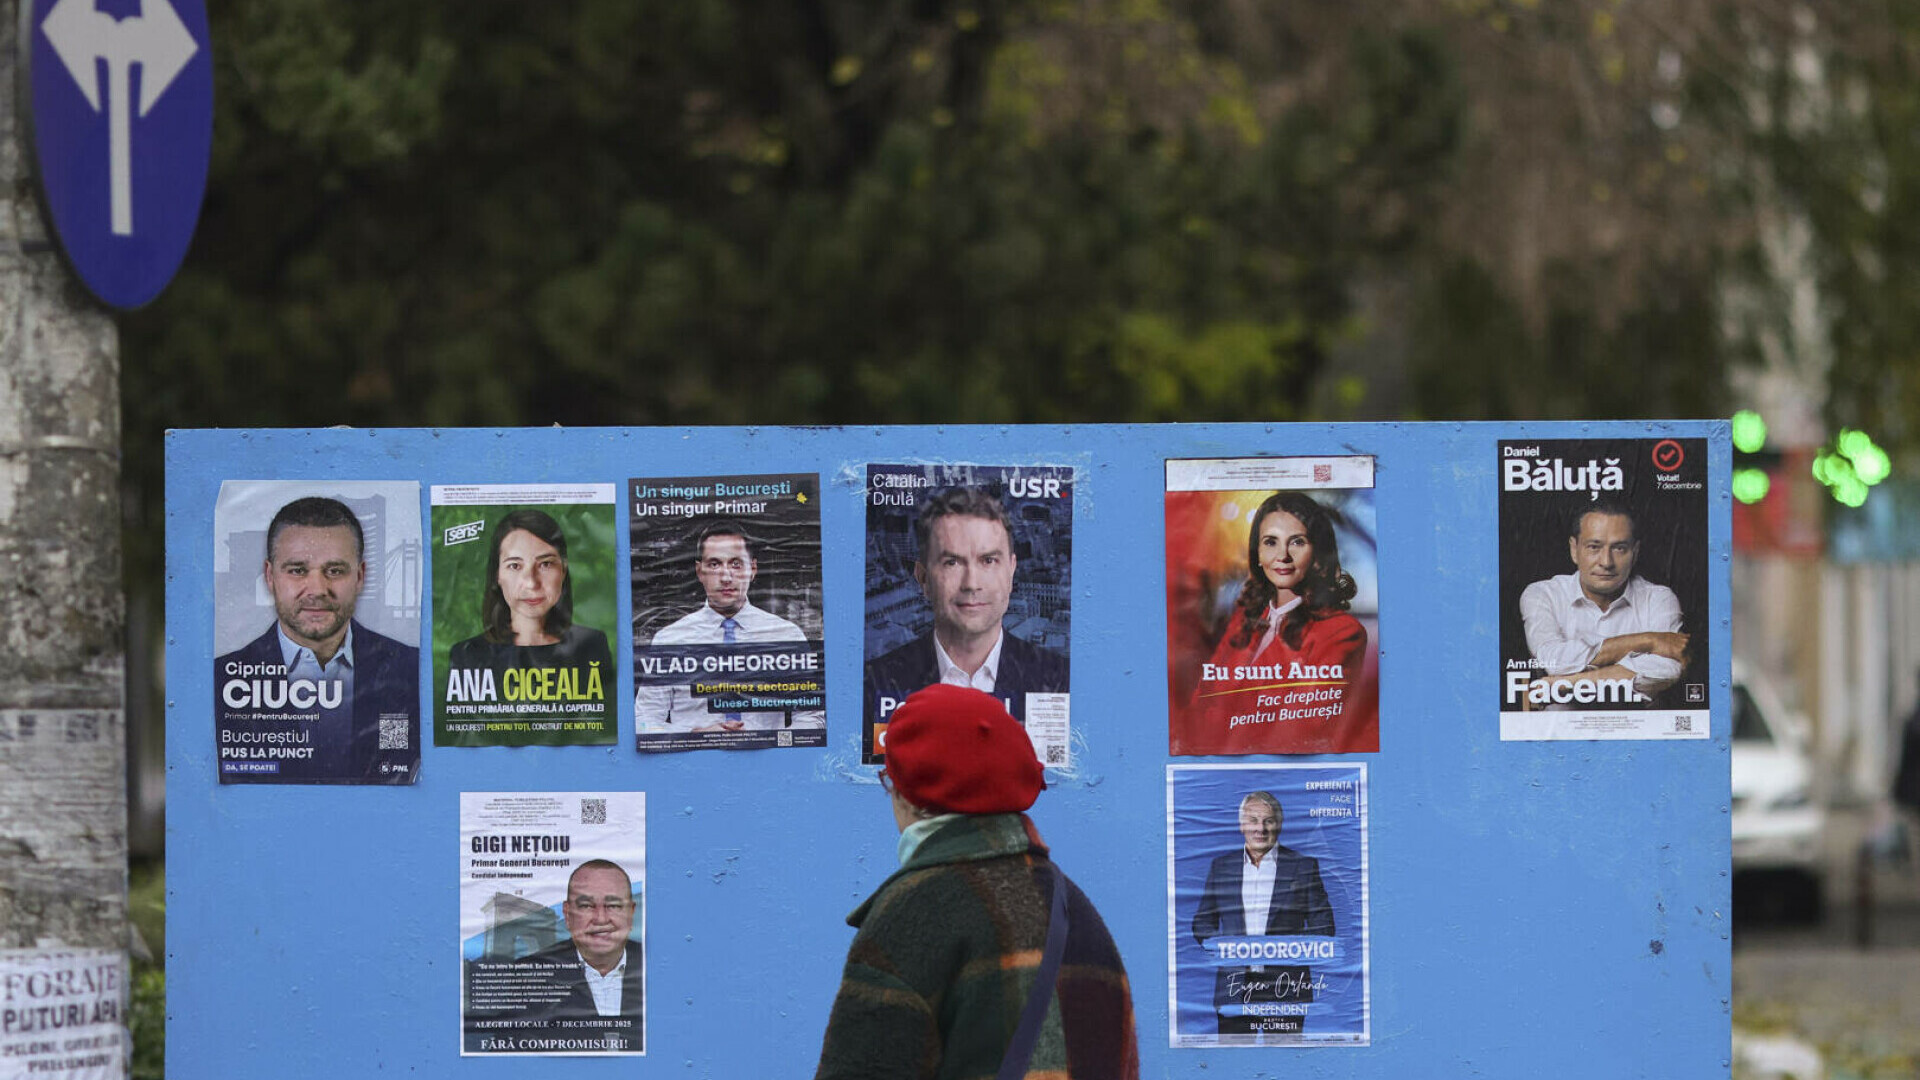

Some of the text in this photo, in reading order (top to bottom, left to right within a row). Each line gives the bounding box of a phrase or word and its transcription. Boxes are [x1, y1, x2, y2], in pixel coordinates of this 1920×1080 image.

[1504, 446, 1540, 457] Daniel
[872, 473, 927, 488] Cătălin
[1504, 458, 1624, 501] Băluță
[1662, 482, 1702, 490] decembrie
[636, 480, 791, 500] Un singur București
[872, 491, 914, 506] Drulă
[636, 500, 767, 517] Un singur Primar
[448, 524, 478, 541] sens
[225, 661, 287, 678] Ciprian
[640, 653, 818, 674] VLAD GHEORGHE
[1202, 661, 1344, 681] Eu sunt Anca
[1506, 658, 1527, 669] Am
[446, 660, 604, 701] ANA CICEALĂ
[1506, 671, 1642, 703] Facem.
[222, 679, 342, 709] CIUCU
[1256, 687, 1342, 707] Fac dreptate
[446, 703, 605, 714] PENTRU PRIMĂRIA GENERALĂ A CAPITALEI
[713, 698, 749, 708] Unesc
[1229, 702, 1342, 730] pentru București
[446, 723, 455, 731] UN
[486, 723, 513, 731] PENTRU
[531, 722, 563, 730] CONSTRUIT
[564, 722, 573, 730] DE
[574, 722, 585, 730] NOI
[222, 729, 309, 747] Bucureștiul
[222, 748, 314, 758] PUS LA PUNCT
[1330, 795, 1351, 803] FACE
[471, 835, 570, 857] GIGI NEȚOIU
[471, 858, 570, 868] Primar General București
[1217, 942, 1334, 959] TEODOROVICI
[1226, 971, 1328, 1003] Eugen Orlando
[3, 1003, 86, 1032] PUTURI
[1242, 1004, 1309, 1015] INDEPENDENT
[515, 1020, 549, 1028] LOCALE
[562, 1020, 612, 1028] DECEMBRIE
[614, 1020, 632, 1028] 2025
[1250, 1022, 1297, 1031] BUCUREȘTI
[480, 1036, 628, 1049] FĂRĂ COMPROMISURI!
